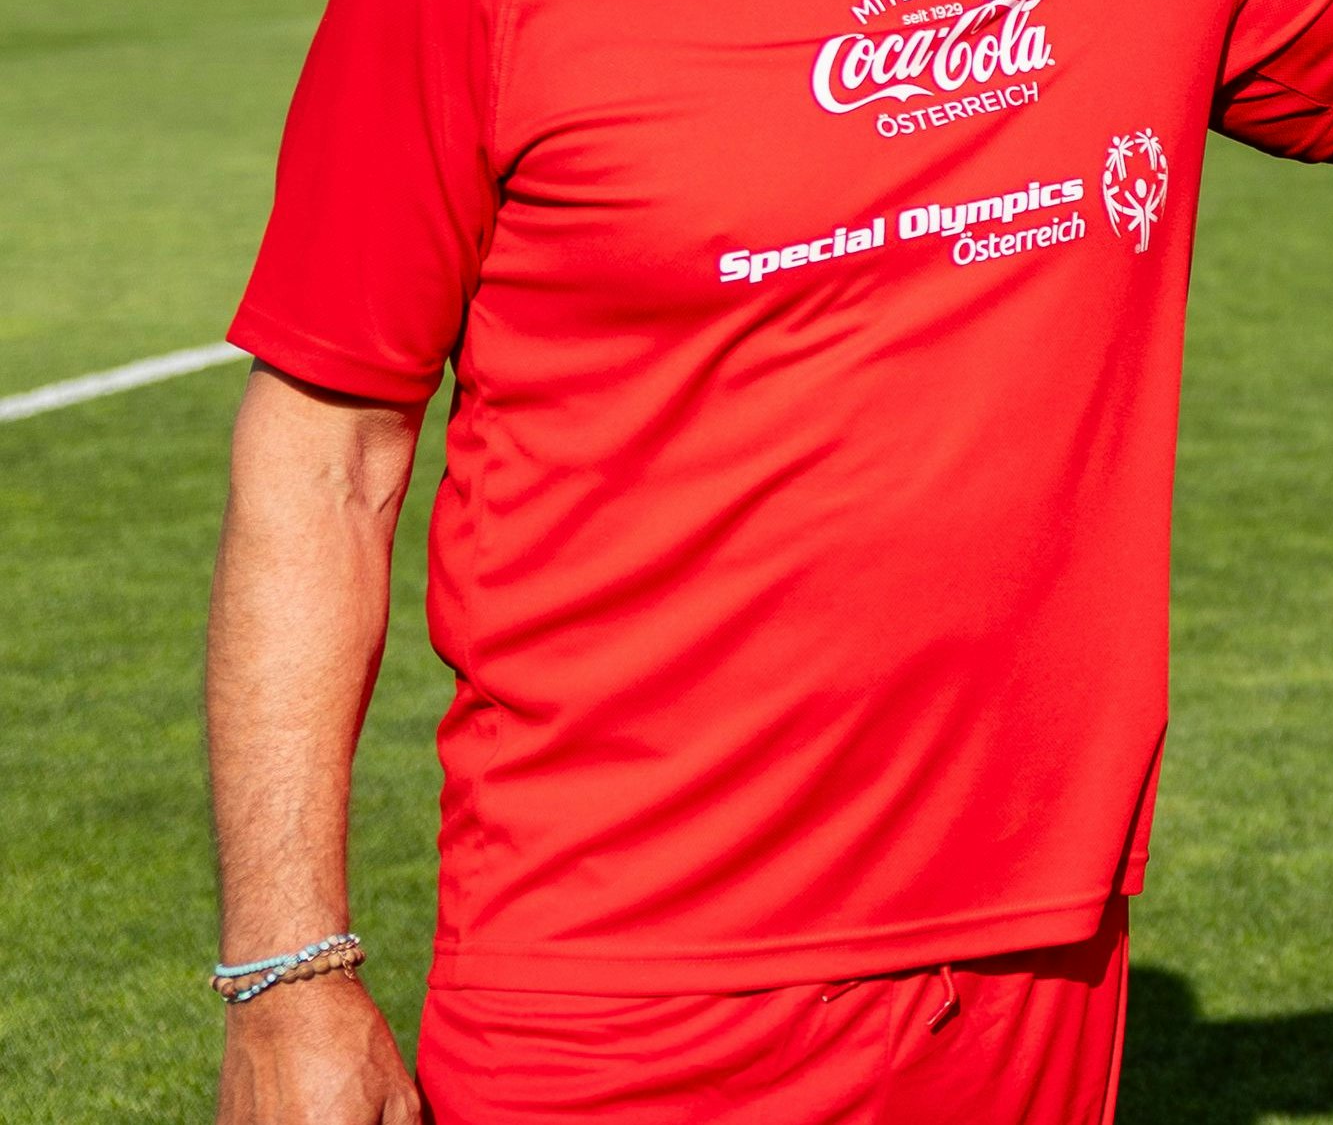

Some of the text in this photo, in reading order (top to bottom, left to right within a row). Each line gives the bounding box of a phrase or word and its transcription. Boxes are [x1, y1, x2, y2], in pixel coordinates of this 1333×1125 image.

[902, 1, 964, 26] seit 1929
[875, 81, 1040, 138] ÖSTERREICH
[719, 177, 1085, 283] Special Olympics
[952, 211, 1087, 267] Österreich
